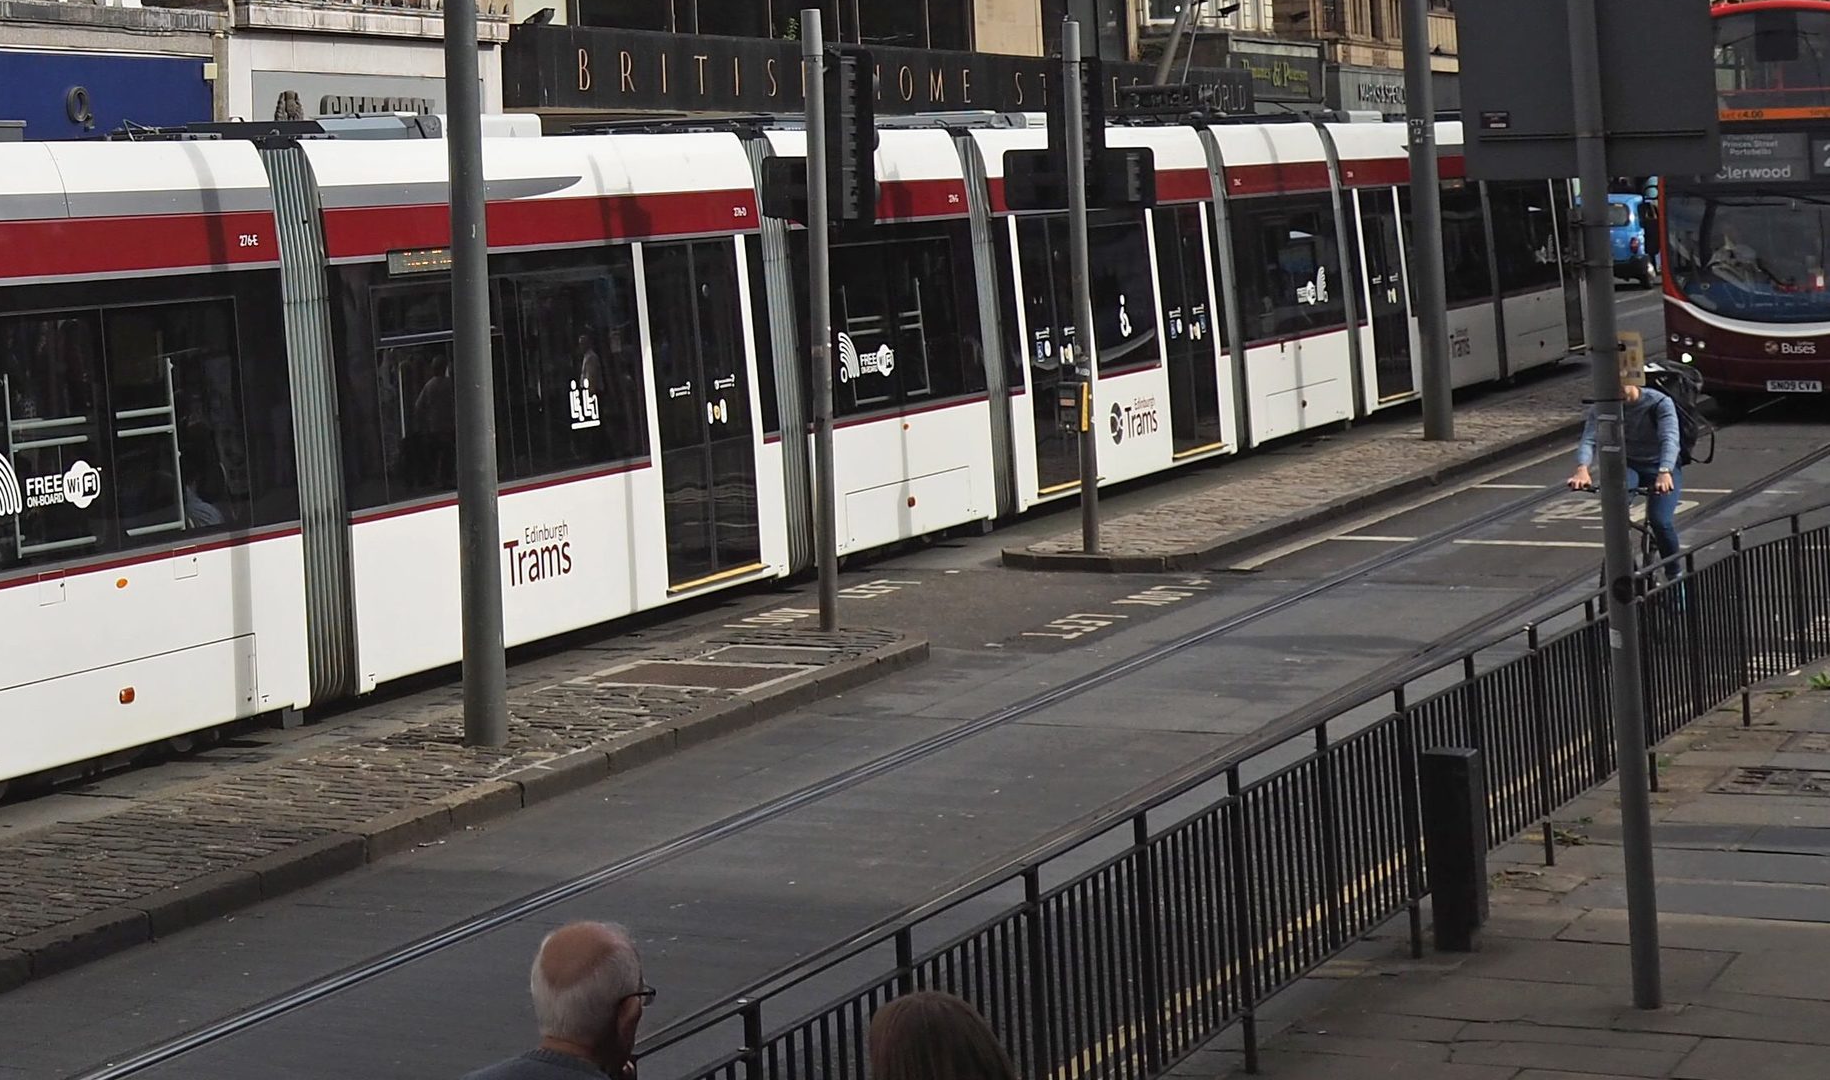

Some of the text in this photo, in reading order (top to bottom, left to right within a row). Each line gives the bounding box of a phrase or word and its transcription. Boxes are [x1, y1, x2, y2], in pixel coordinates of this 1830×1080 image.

[578, 48, 806, 98] BRITIS
[1781, 342, 1816, 354] Buses
[1124, 406, 1158, 439] Trams
[25, 474, 63, 496] FREE
[26, 492, 64, 508] ON-BOARD
[524, 520, 569, 545] Edinburgh
[503, 539, 572, 587] Trams
